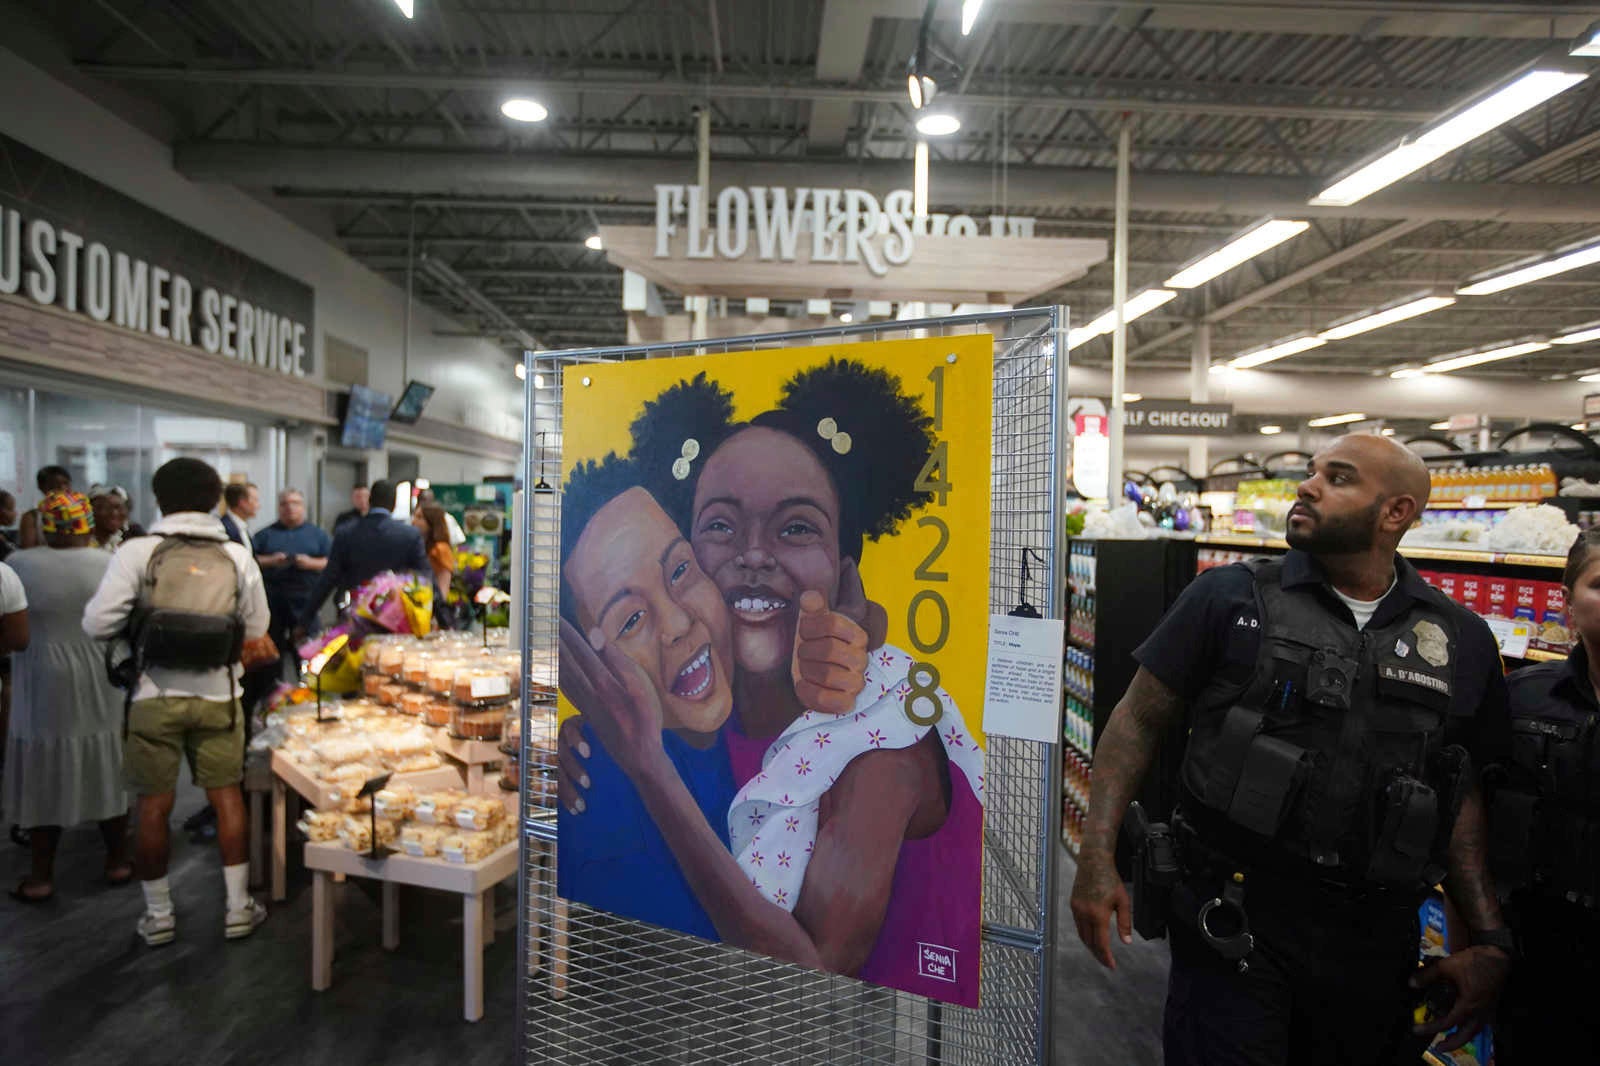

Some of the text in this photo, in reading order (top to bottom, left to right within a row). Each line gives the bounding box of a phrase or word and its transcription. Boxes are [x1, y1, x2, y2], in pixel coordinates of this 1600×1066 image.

[654, 184, 914, 275] FLOWERS
[201, 288, 306, 377] SERVICE
[1123, 410, 1229, 428] ELF CHECKOUT
[1237, 616, 1248, 626] A.
[1386, 667, 1397, 678] A.
[927, 962, 945, 976] CHE
